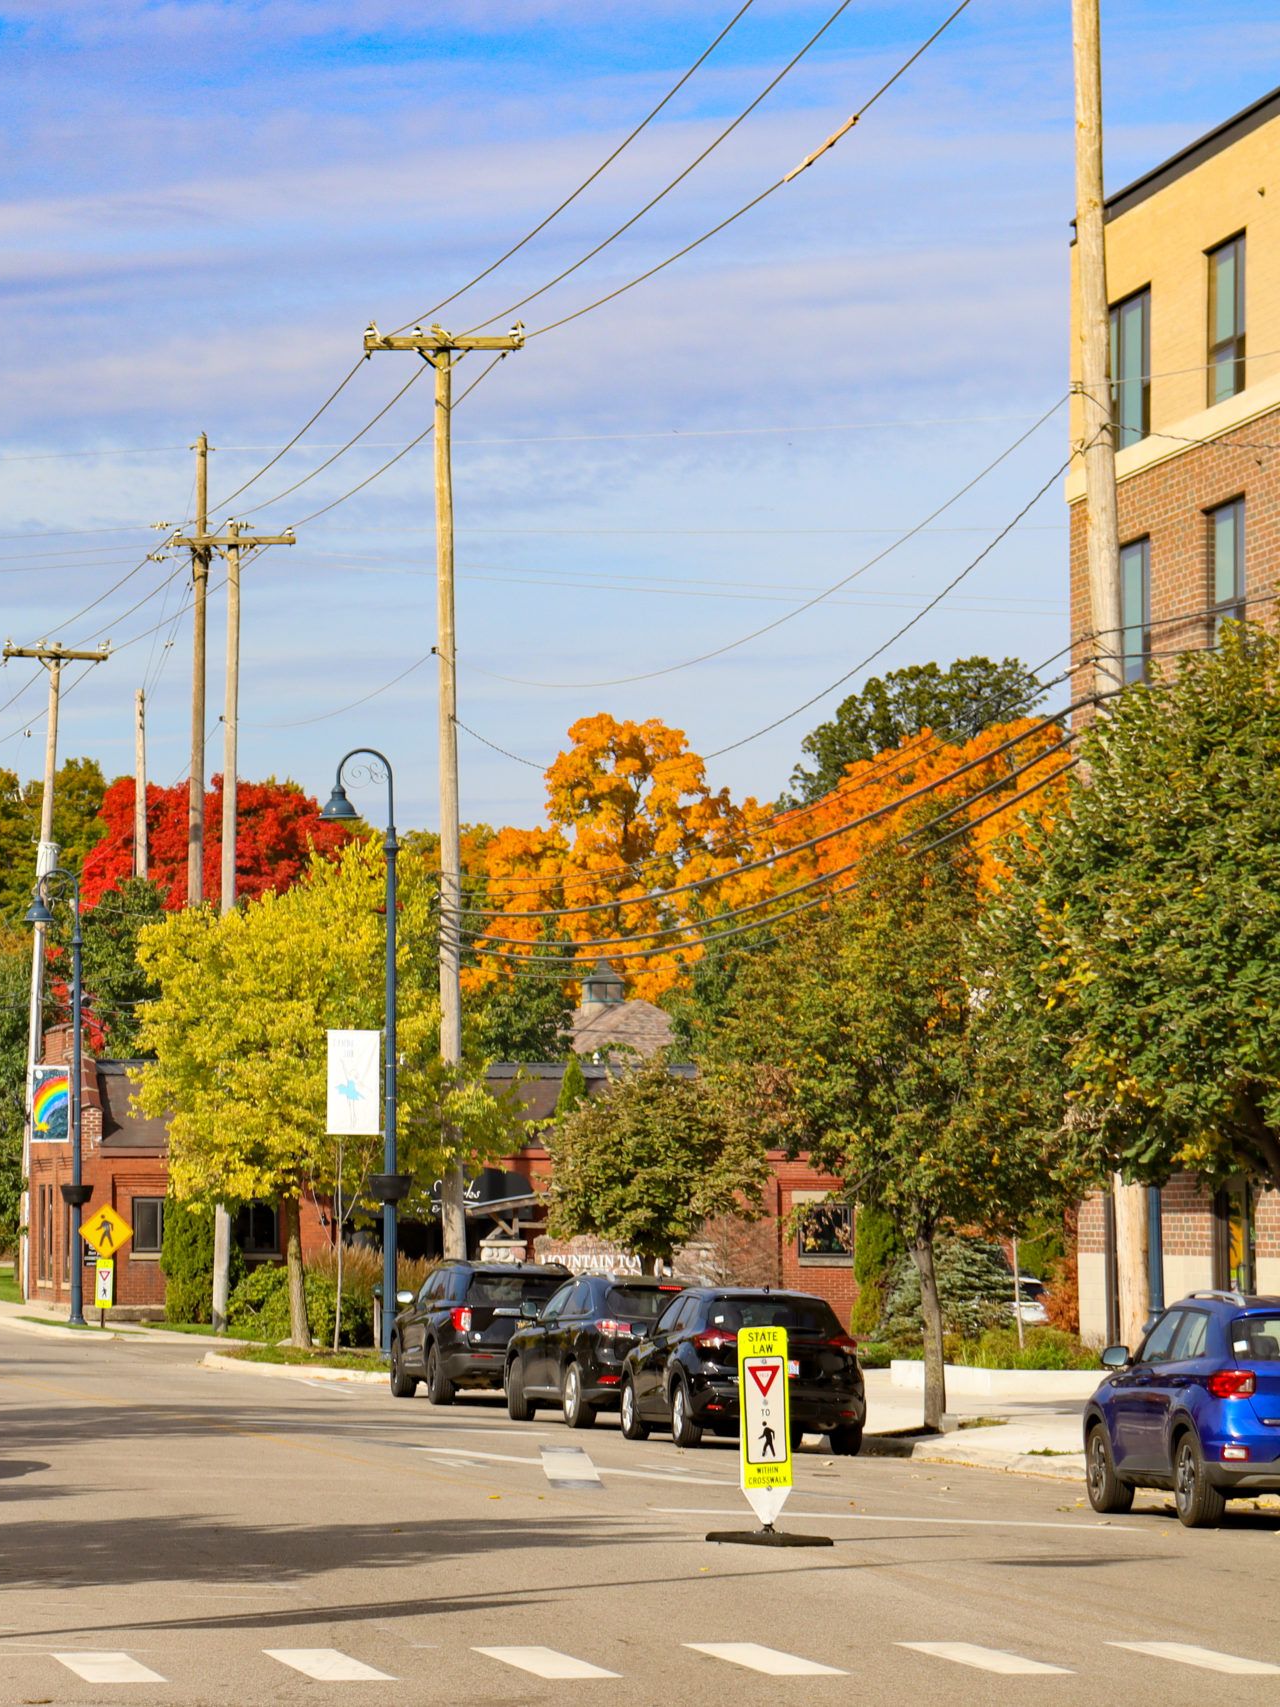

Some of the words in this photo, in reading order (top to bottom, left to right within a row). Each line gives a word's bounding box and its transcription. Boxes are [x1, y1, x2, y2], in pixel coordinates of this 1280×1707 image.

[748, 1331, 779, 1342] STATE
[752, 1344, 774, 1354] LAW
[761, 1409, 771, 1417] TO
[748, 1476, 788, 1485] CROSSWALK
